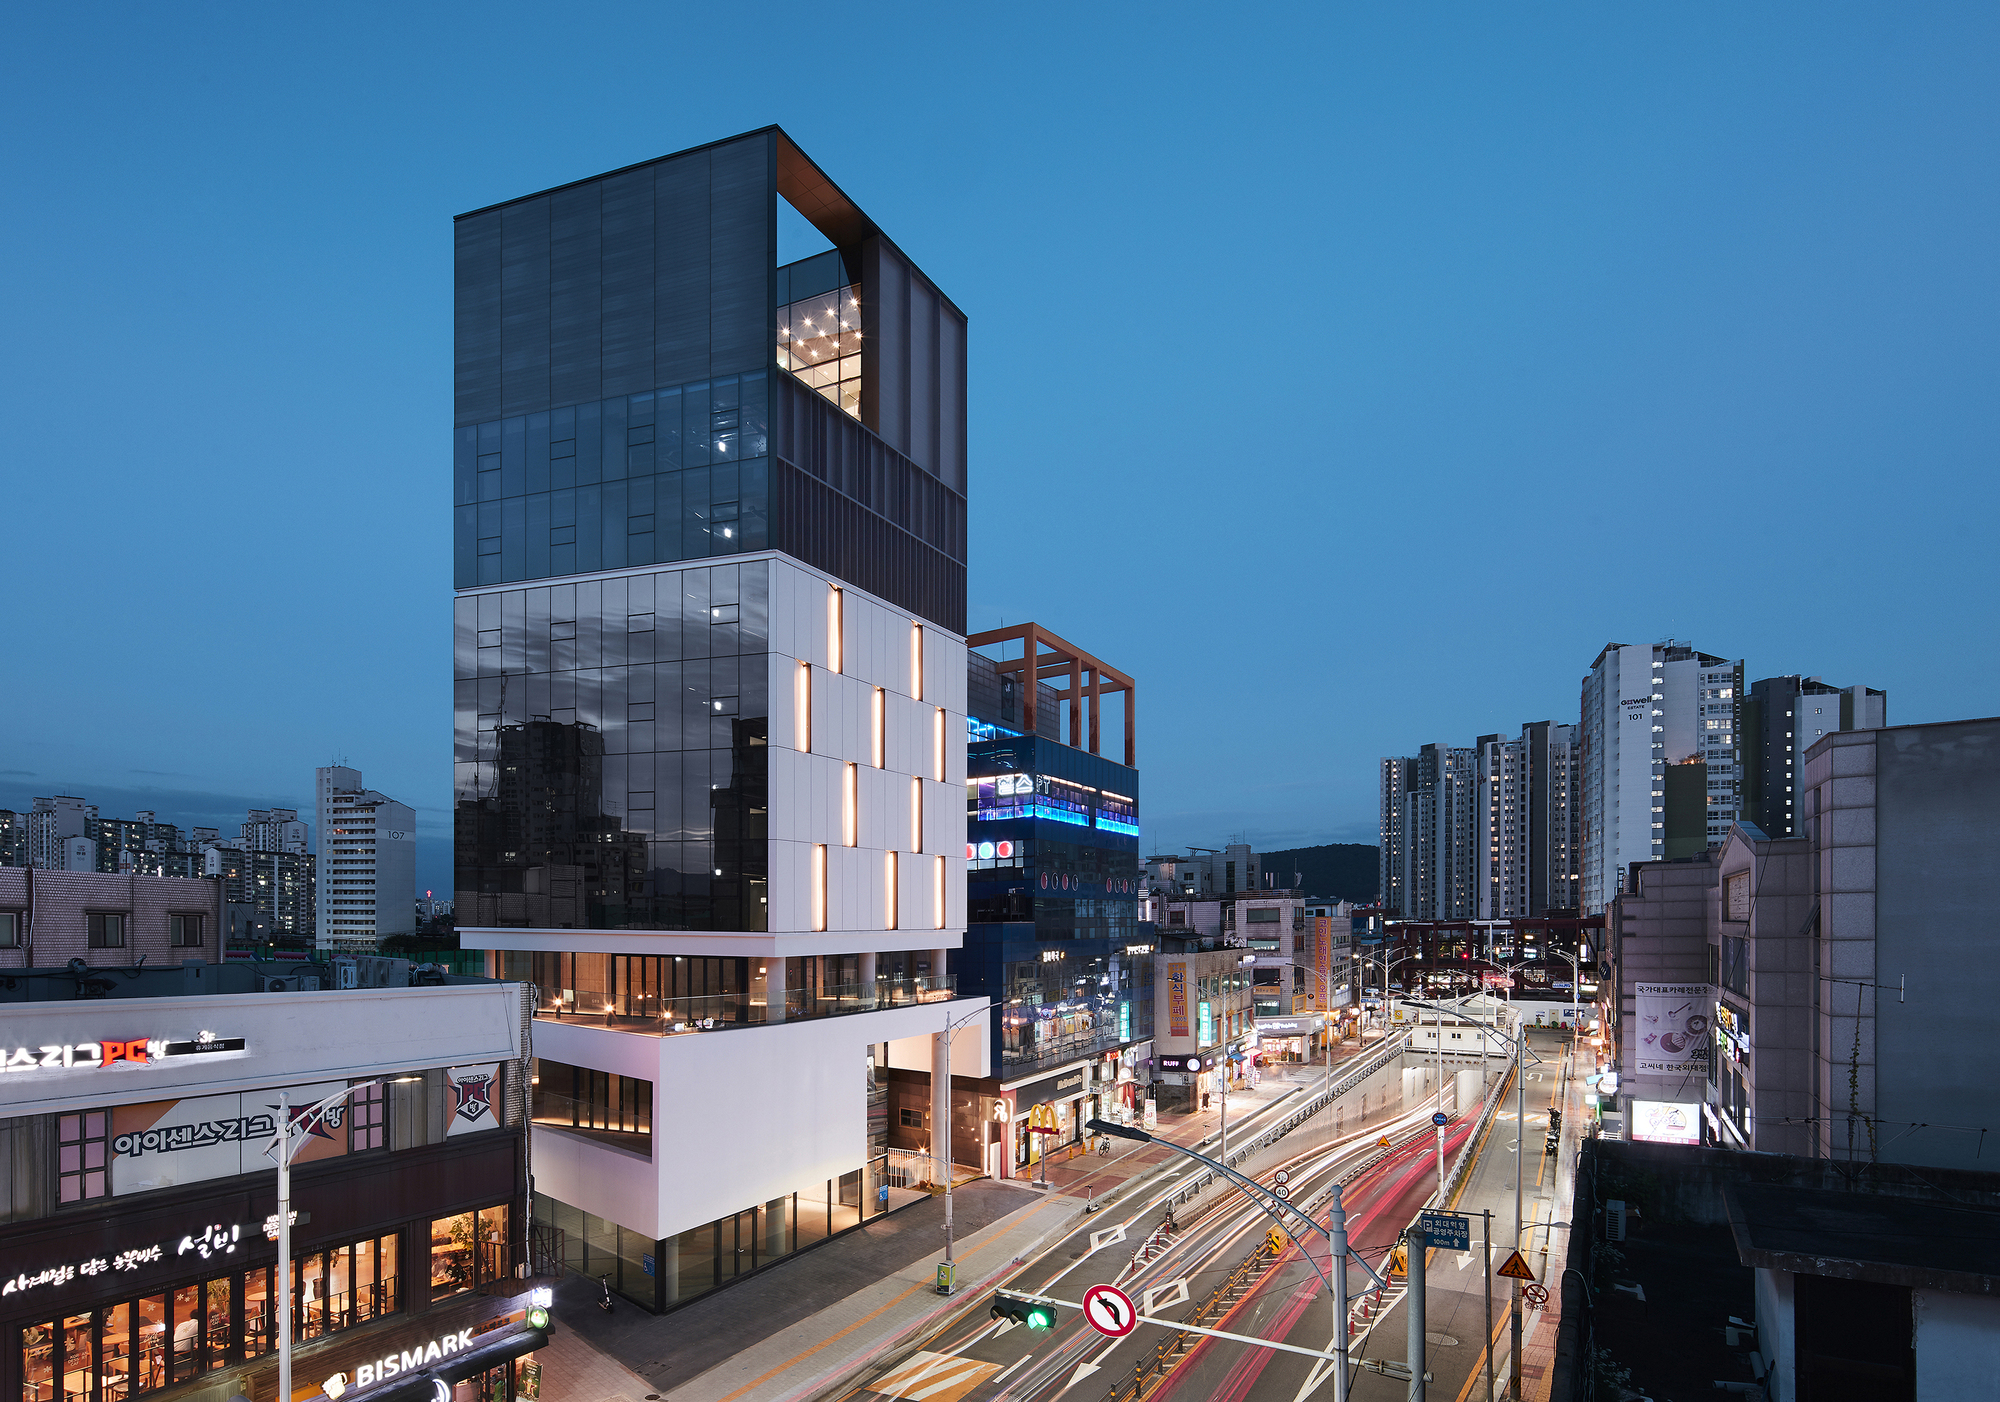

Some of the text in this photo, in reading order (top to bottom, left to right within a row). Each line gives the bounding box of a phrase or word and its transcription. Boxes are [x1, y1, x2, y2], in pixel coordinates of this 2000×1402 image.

[387, 830, 405, 840] 107
[1171, 971, 1185, 1016] 한식부페
[199, 1030, 216, 1043] 3F
[1639, 1062, 1664, 1070] 고씨네
[460, 1081, 488, 1106] PC
[178, 1224, 240, 1259] 설빙
[1433, 1227, 1468, 1239] 공영주차장
[1433, 1238, 1450, 1246] 100m
[2, 1244, 164, 1297] 사계절을 담은 눈꽃빙수
[356, 1326, 474, 1389] BISMARK
